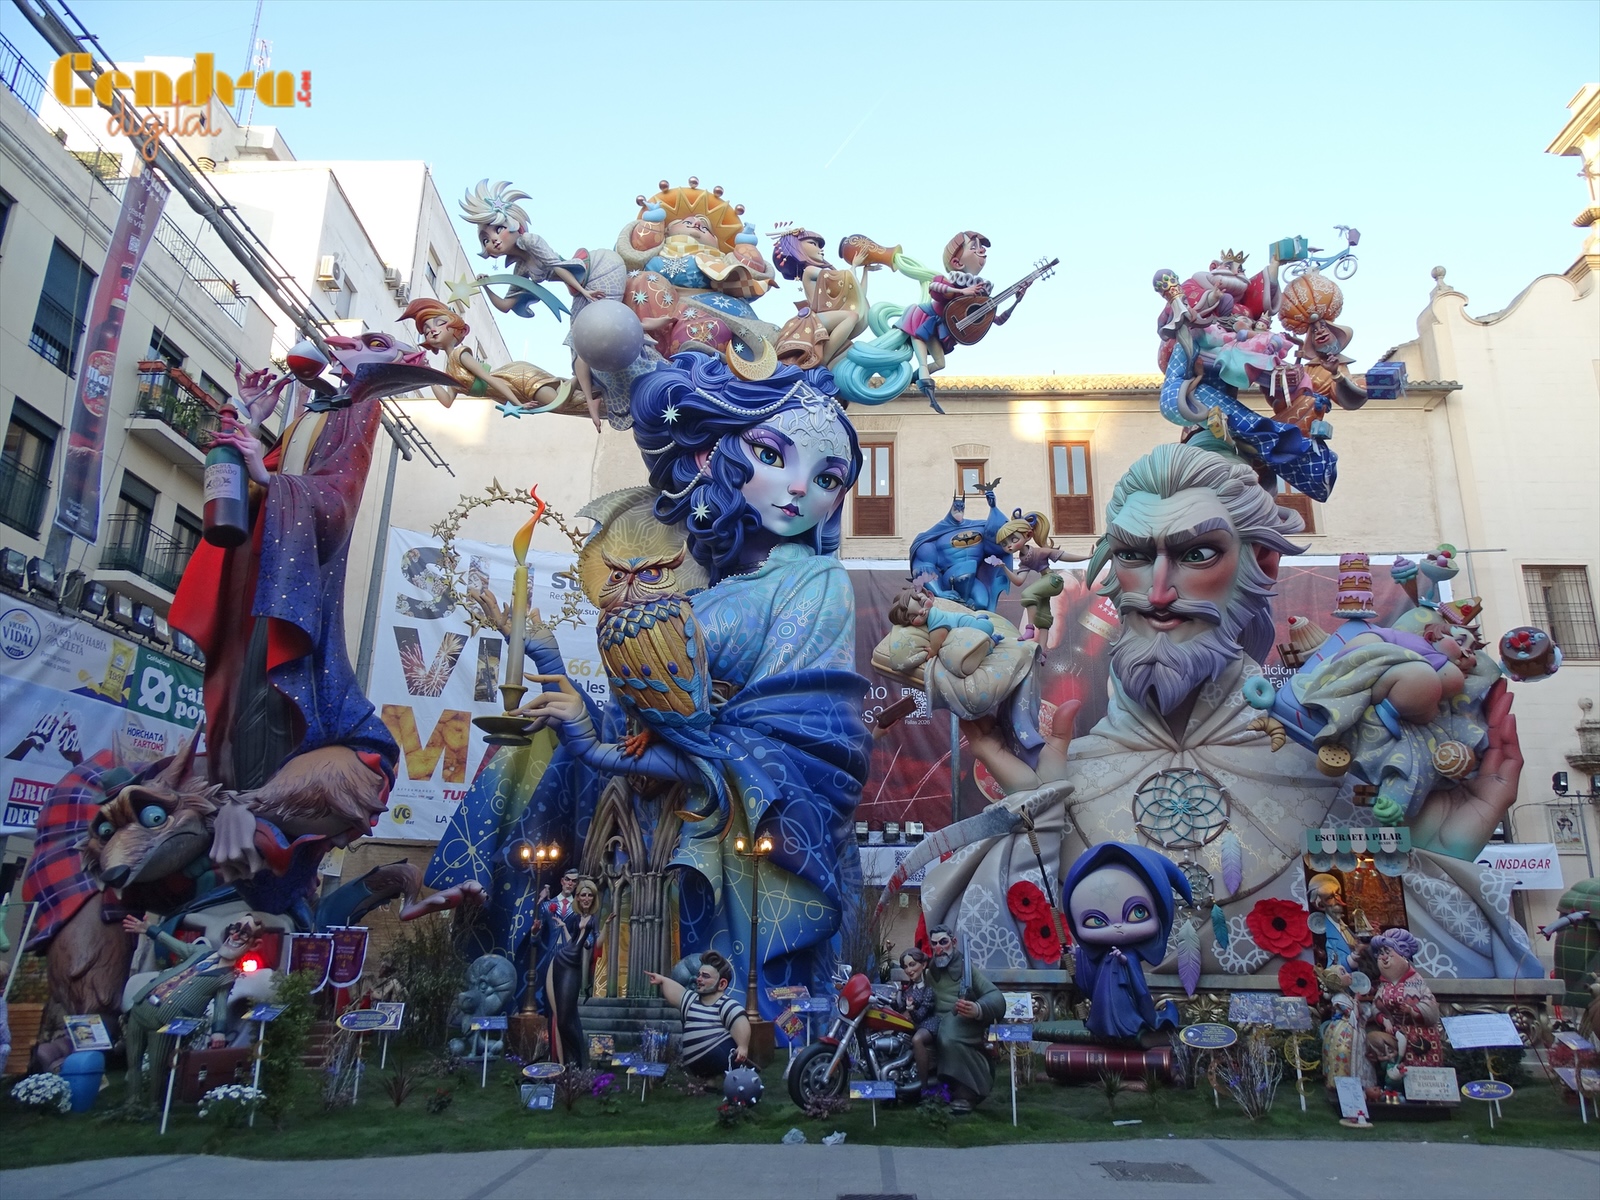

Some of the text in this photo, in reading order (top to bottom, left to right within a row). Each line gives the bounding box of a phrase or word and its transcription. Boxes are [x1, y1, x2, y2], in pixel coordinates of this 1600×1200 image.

[3, 625, 34, 648] VIDAL
[567, 658, 592, 677] 66
[586, 680, 606, 694] les
[126, 727, 164, 742] HORCHATA
[133, 738, 164, 752] FARTONS
[394, 807, 411, 820] VG
[435, 815, 448, 823] LA
[1315, 832, 1402, 842] ESCURAETA PILAR
[1495, 858, 1551, 870] INSDAGAR
